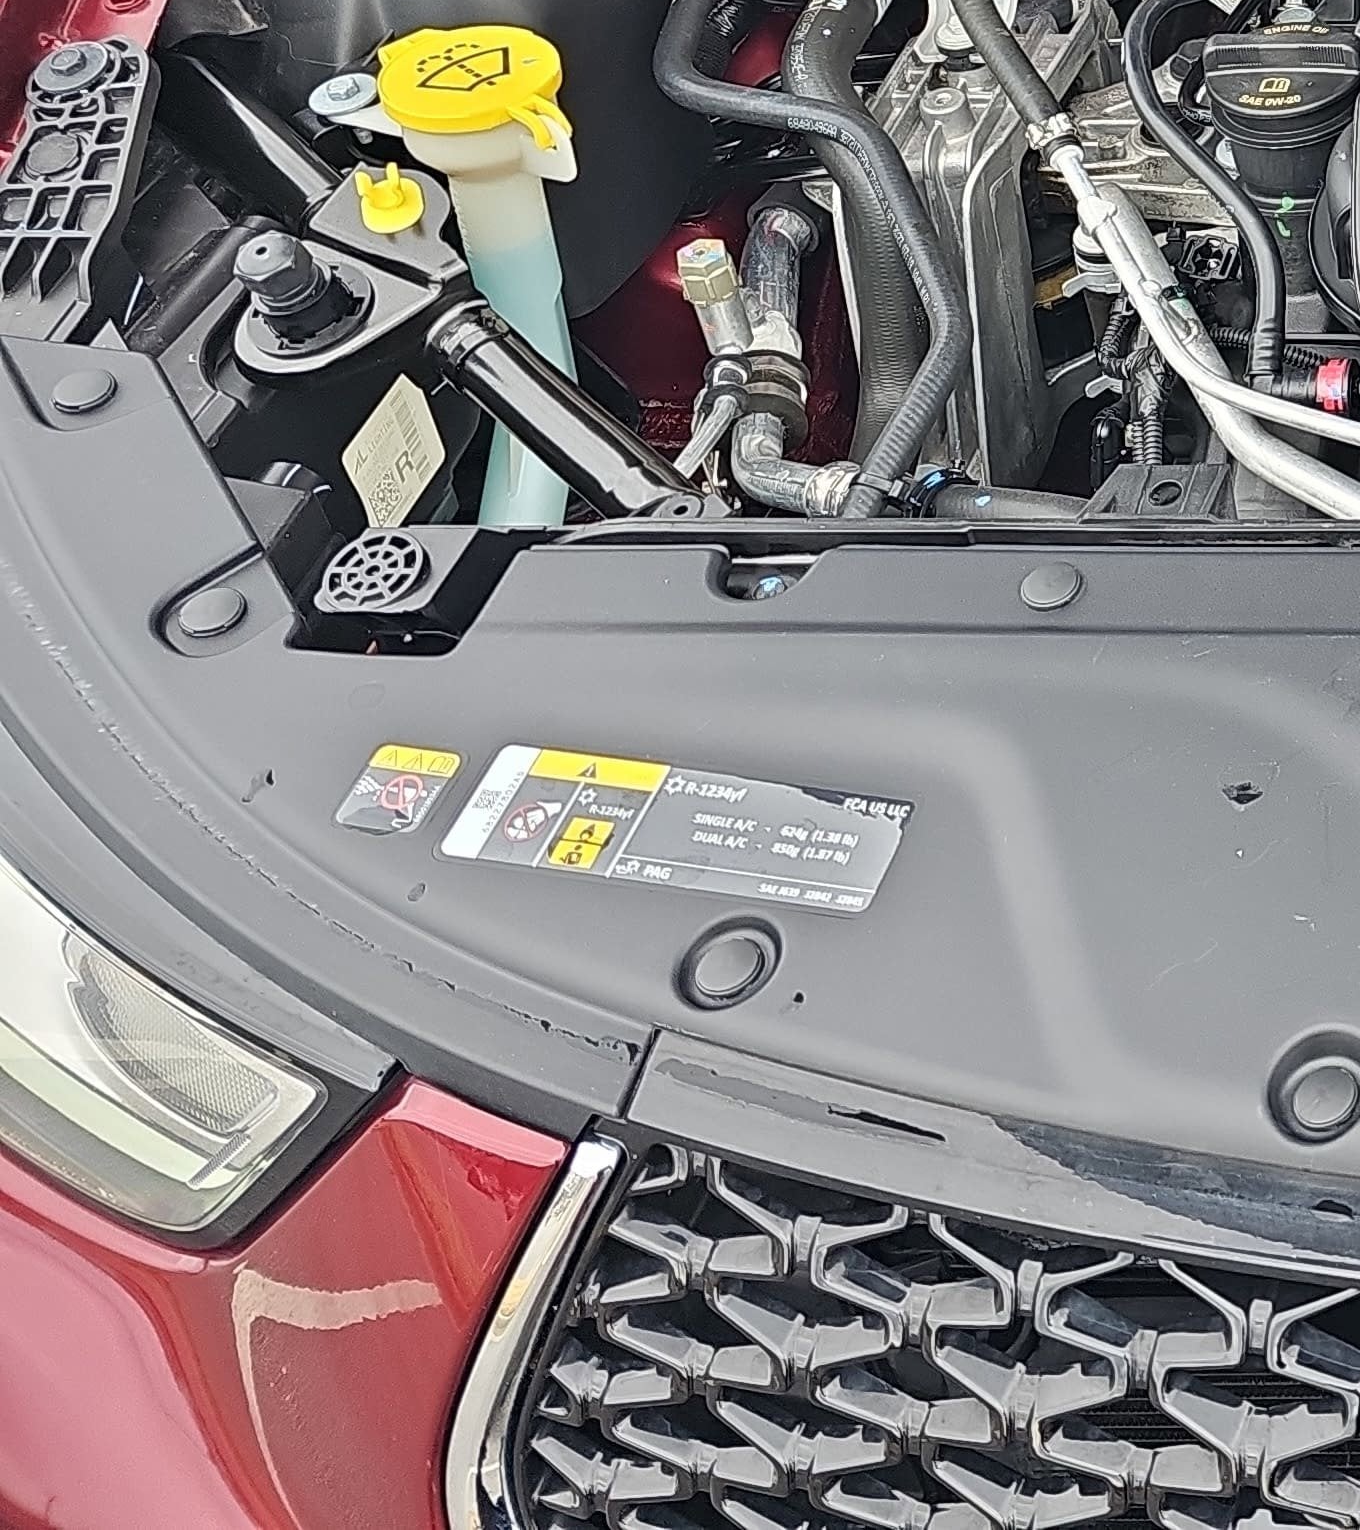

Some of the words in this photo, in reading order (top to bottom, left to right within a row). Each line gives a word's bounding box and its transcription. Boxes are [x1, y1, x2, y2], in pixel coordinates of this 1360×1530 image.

[1263, 24, 1312, 35] ENGINE
[1311, 26, 1331, 35] OIL
[1238, 94, 1265, 106] SAE
[1264, 94, 1302, 107] 0W-20
[395, 450, 414, 484] R
[684, 782, 748, 803] R-1234yf
[843, 797, 867, 813] FCA
[869, 800, 887, 814] US
[887, 803, 910, 818] LLC
[692, 813, 736, 829] SINGLE
[736, 818, 758, 833] A/C
[841, 833, 860, 848] lb)
[692, 830, 725, 846] DUAL
[726, 834, 748, 849] A/C
[832, 849, 851, 866] lb)
[643, 864, 673, 880] PAG
